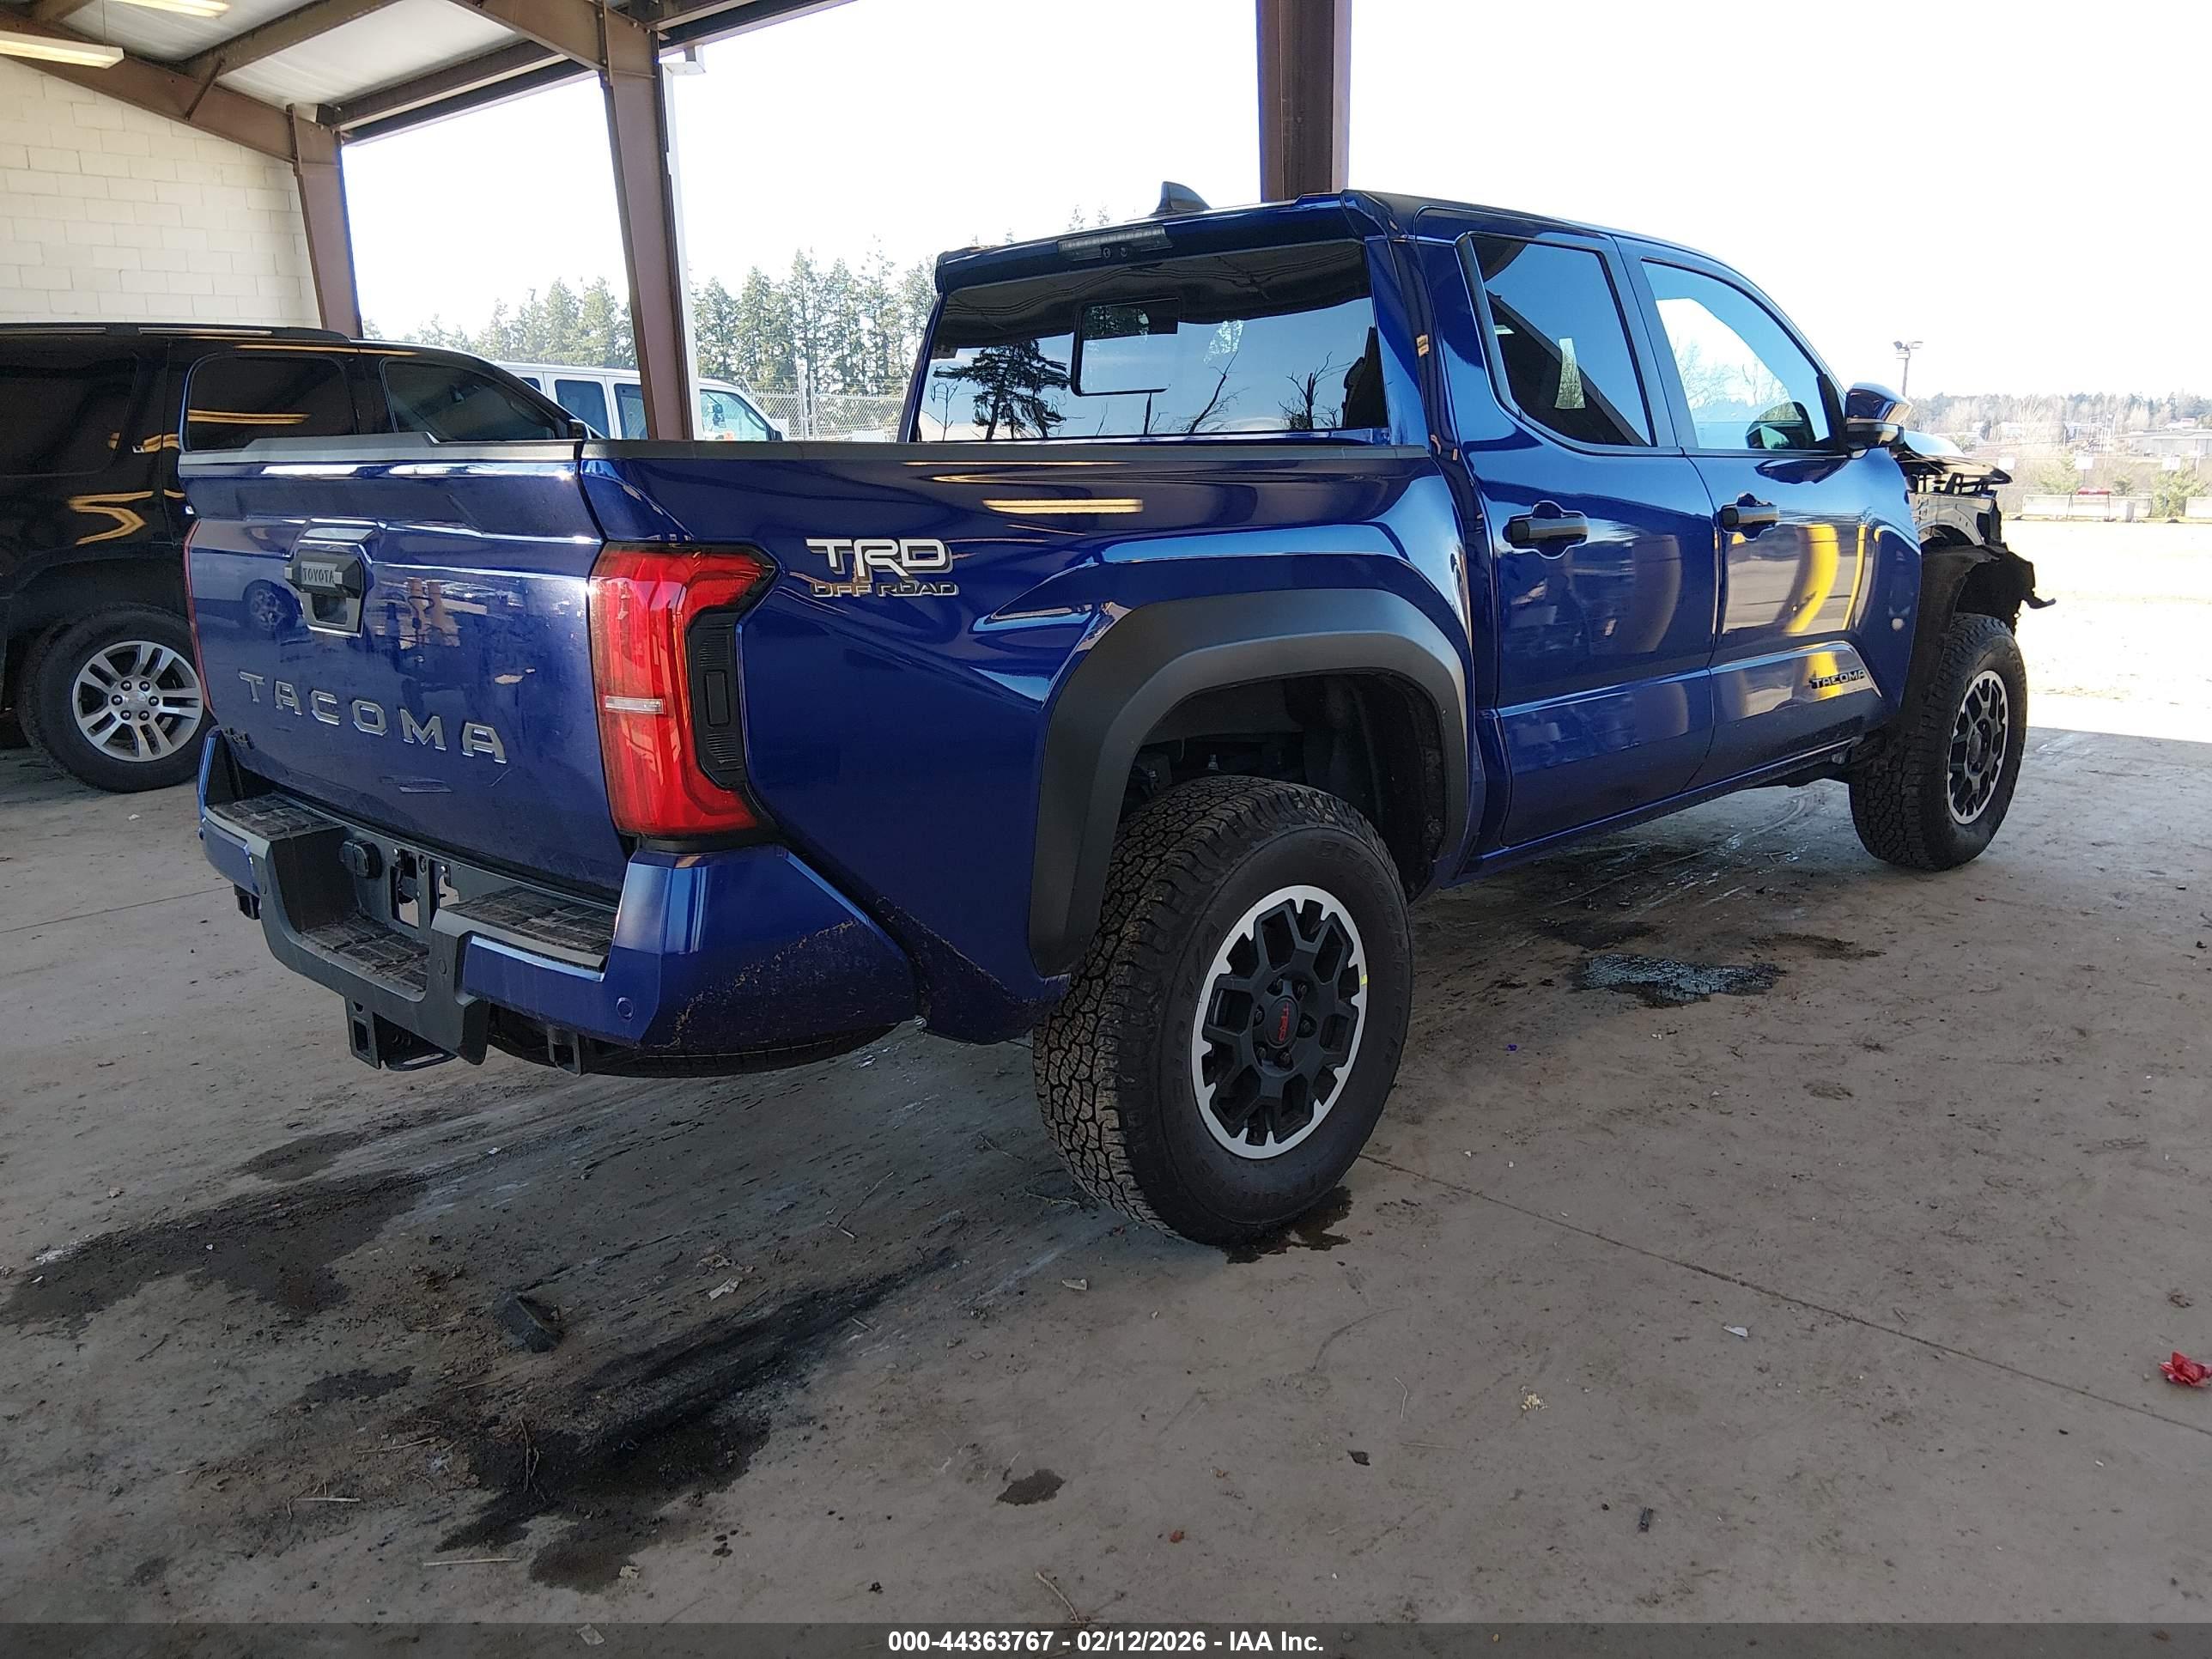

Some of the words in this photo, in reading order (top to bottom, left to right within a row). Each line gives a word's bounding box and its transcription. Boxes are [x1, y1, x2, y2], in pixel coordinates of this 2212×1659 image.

[805, 538, 954, 584] TRD
[303, 568, 336, 583] TOYOTA
[811, 581, 873, 597] OFF
[876, 581, 959, 597] ROAD
[1810, 670, 1866, 689] TACOMA
[238, 671, 508, 764] TACOMA
